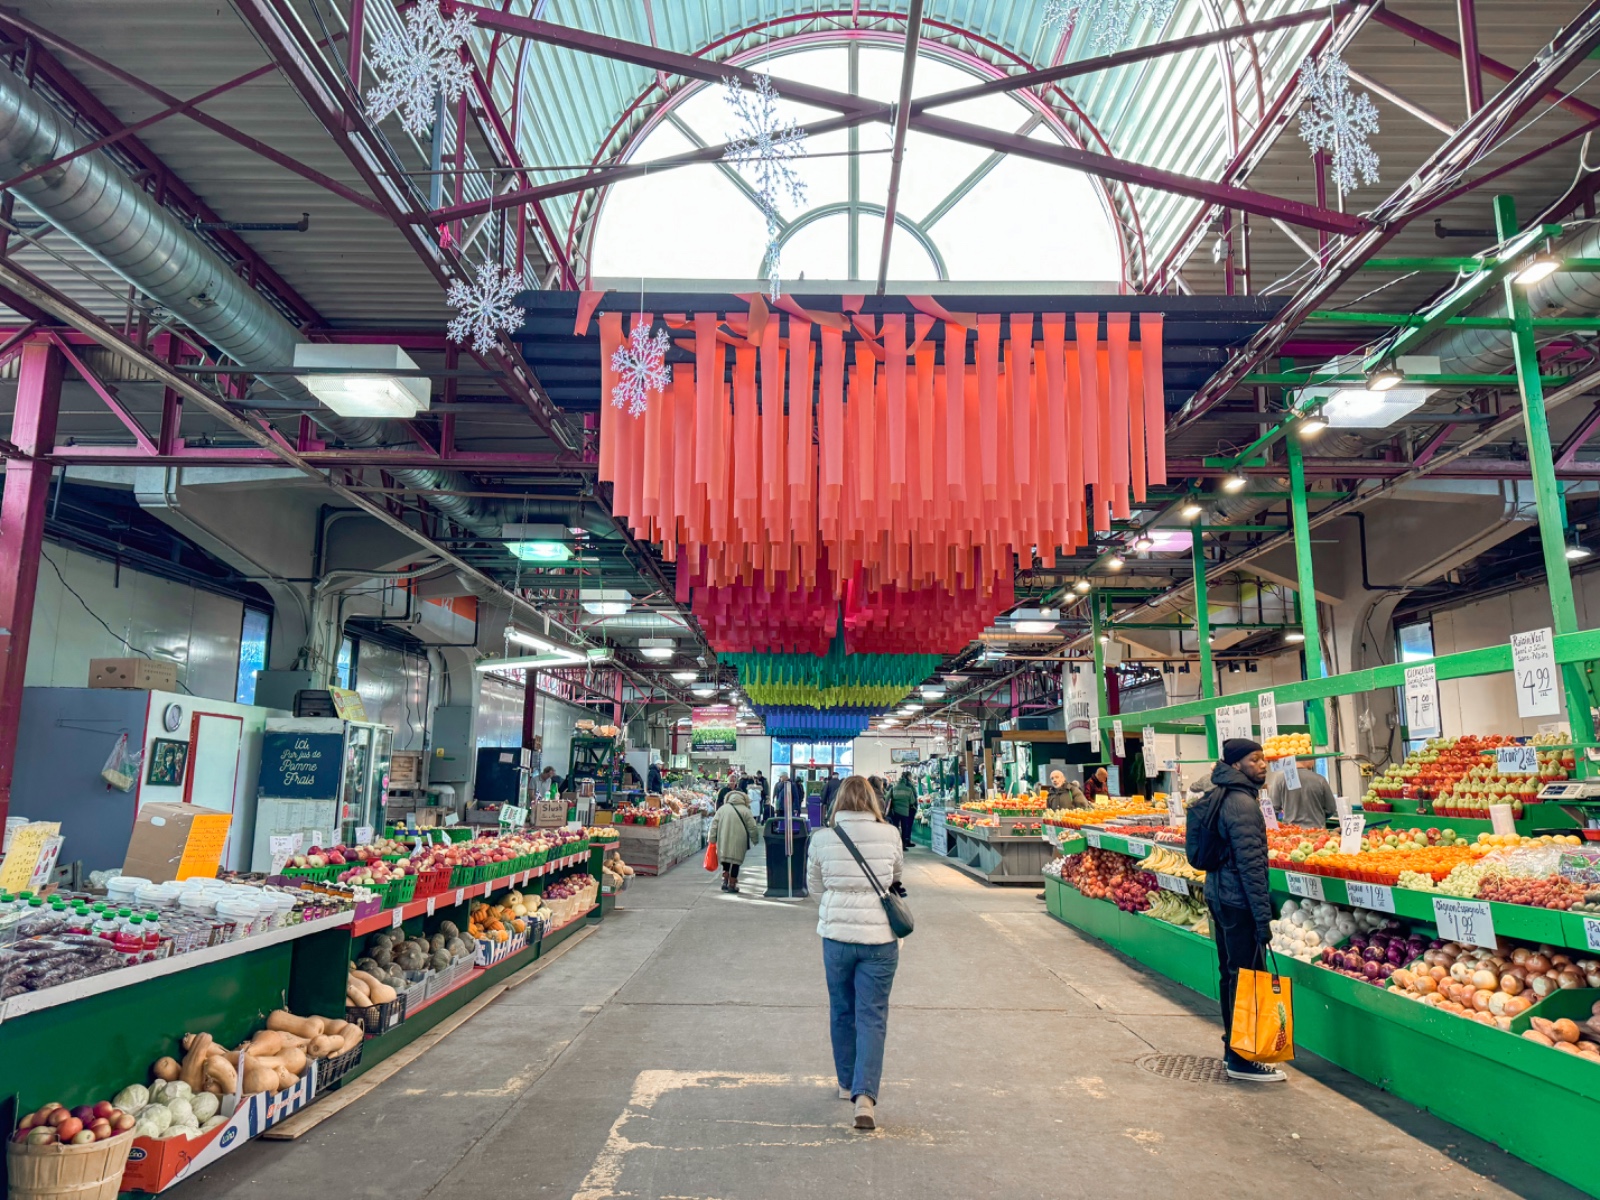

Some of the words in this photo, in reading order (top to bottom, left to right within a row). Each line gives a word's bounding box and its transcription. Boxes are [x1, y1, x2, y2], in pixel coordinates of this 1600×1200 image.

[296, 750, 311, 761] jus
[312, 750, 322, 759] de
[279, 759, 318, 772] Pomme
[283, 771, 315, 786] Frais
[542, 803, 563, 812] Slush
